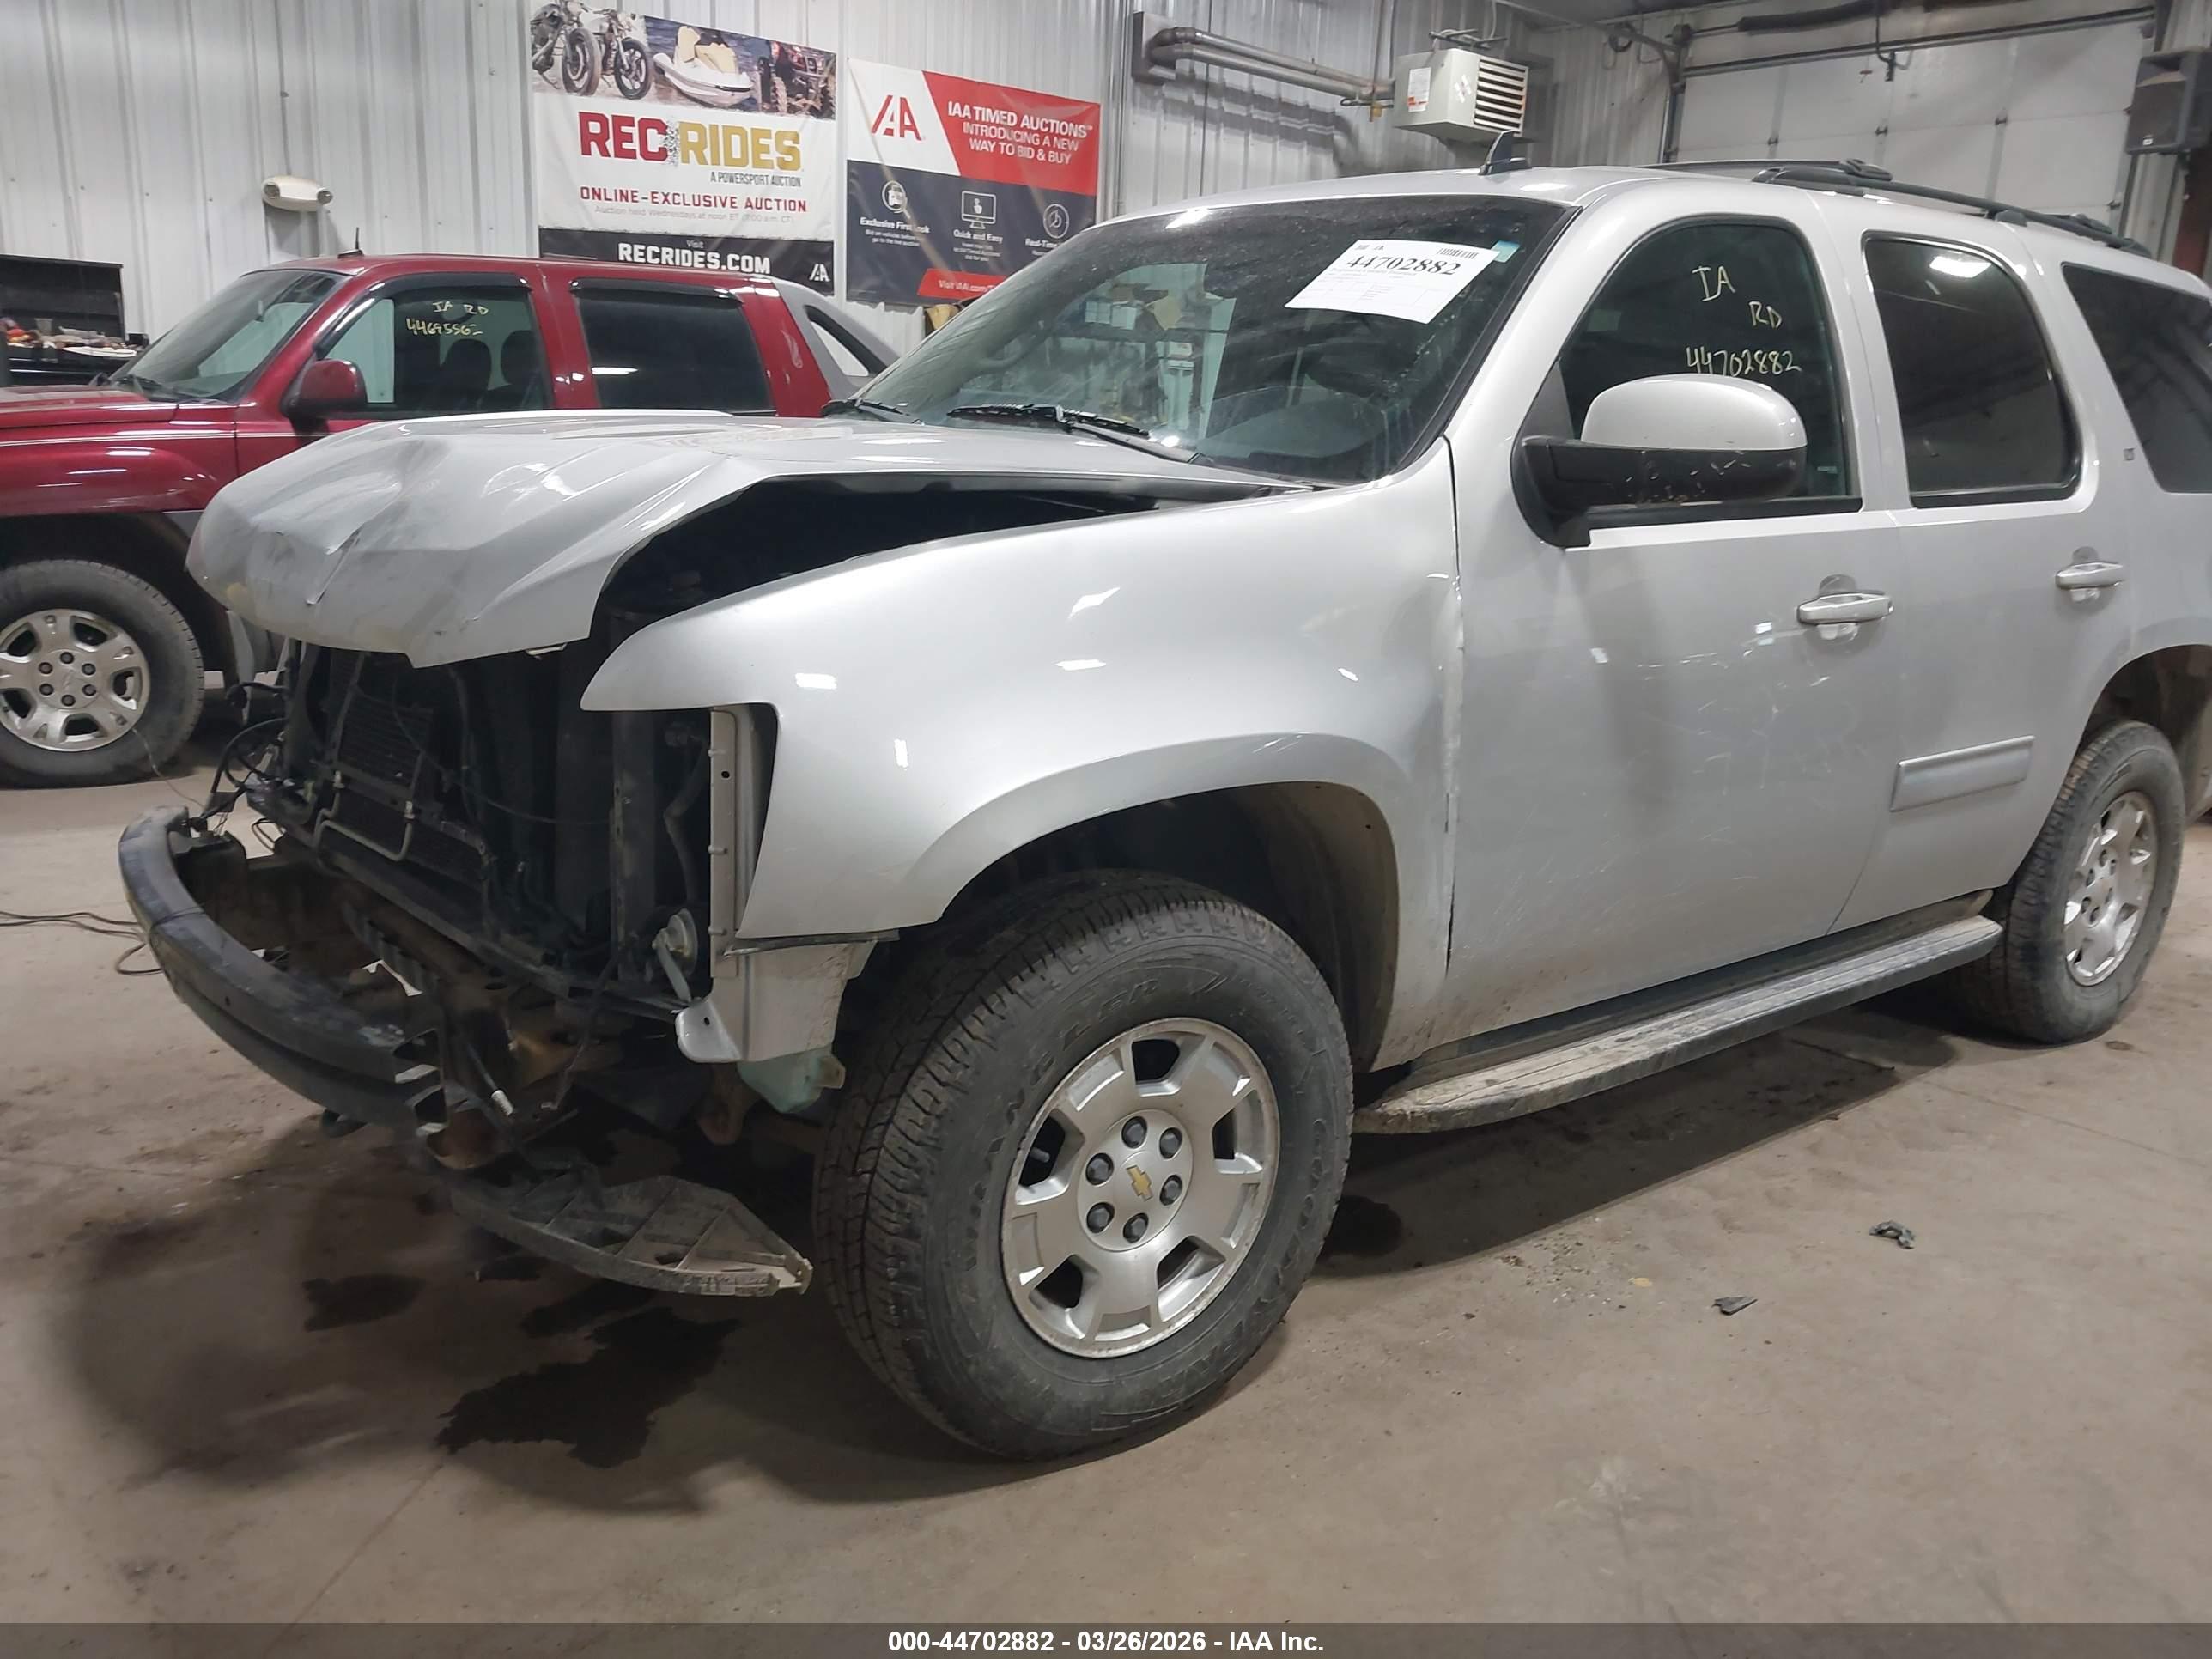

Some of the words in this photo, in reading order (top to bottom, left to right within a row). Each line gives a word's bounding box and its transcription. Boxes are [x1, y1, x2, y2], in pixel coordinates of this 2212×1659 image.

[948, 100, 972, 119] IAA
[973, 106, 1018, 126] TIMED
[579, 112, 668, 161] REC
[678, 121, 802, 172] RIDES
[963, 121, 1041, 144] INTRODUCING
[1043, 135, 1052, 147] A
[1053, 137, 1079, 152] NEW
[969, 137, 995, 154] WAY
[999, 142, 1015, 156] TO
[1018, 145, 1035, 159] BID
[1036, 147, 1046, 161] &
[1048, 150, 1072, 165] BUY
[710, 172, 716, 182] A
[718, 173, 769, 185] POWERSPORT
[771, 175, 801, 188] AUCTION
[580, 186, 738, 210] ONLINE-EXCLUSIVE
[744, 196, 807, 212] AUCTION
[860, 216, 895, 229] Exclusive
[953, 228, 972, 240] Quick
[987, 233, 1003, 245] Easy
[618, 242, 771, 275] RECRIDES.COM
[1346, 255, 1462, 276] 44702882
[1748, 301, 1783, 329] RD
[1686, 345, 1802, 377] 44702882
